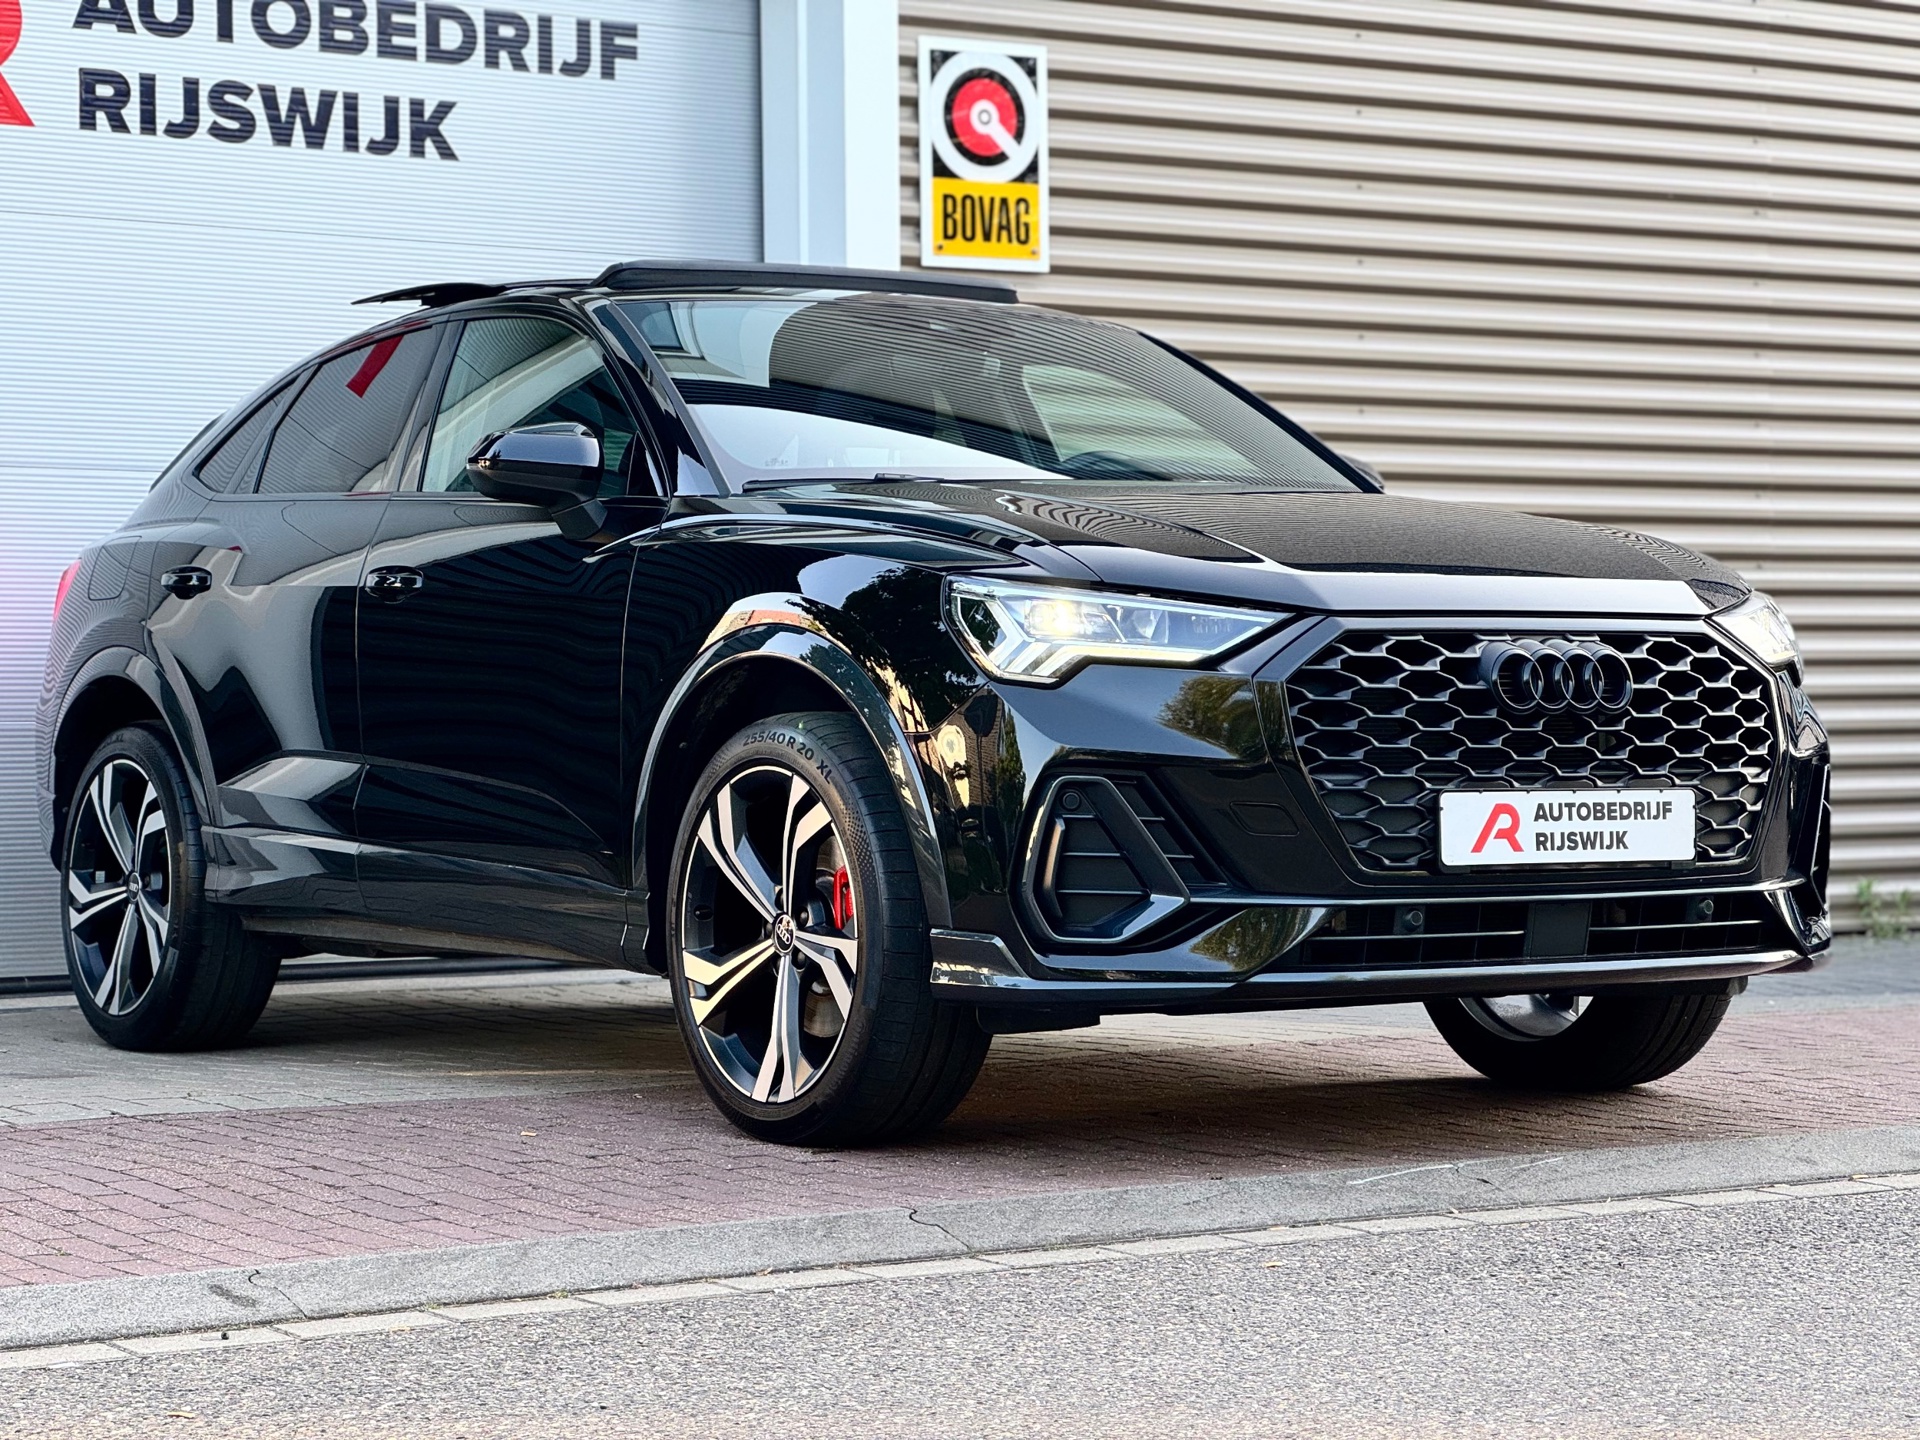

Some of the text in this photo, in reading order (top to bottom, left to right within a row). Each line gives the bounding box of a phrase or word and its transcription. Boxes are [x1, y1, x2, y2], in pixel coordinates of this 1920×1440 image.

[78, 67, 460, 162] RIJSWIJK
[942, 193, 1031, 246] BOVAG
[743, 730, 833, 785] 255/40 R 20 XL
[1533, 801, 1673, 822] AUTOBEDRIJF
[1535, 830, 1629, 852] RIJSWIJK
